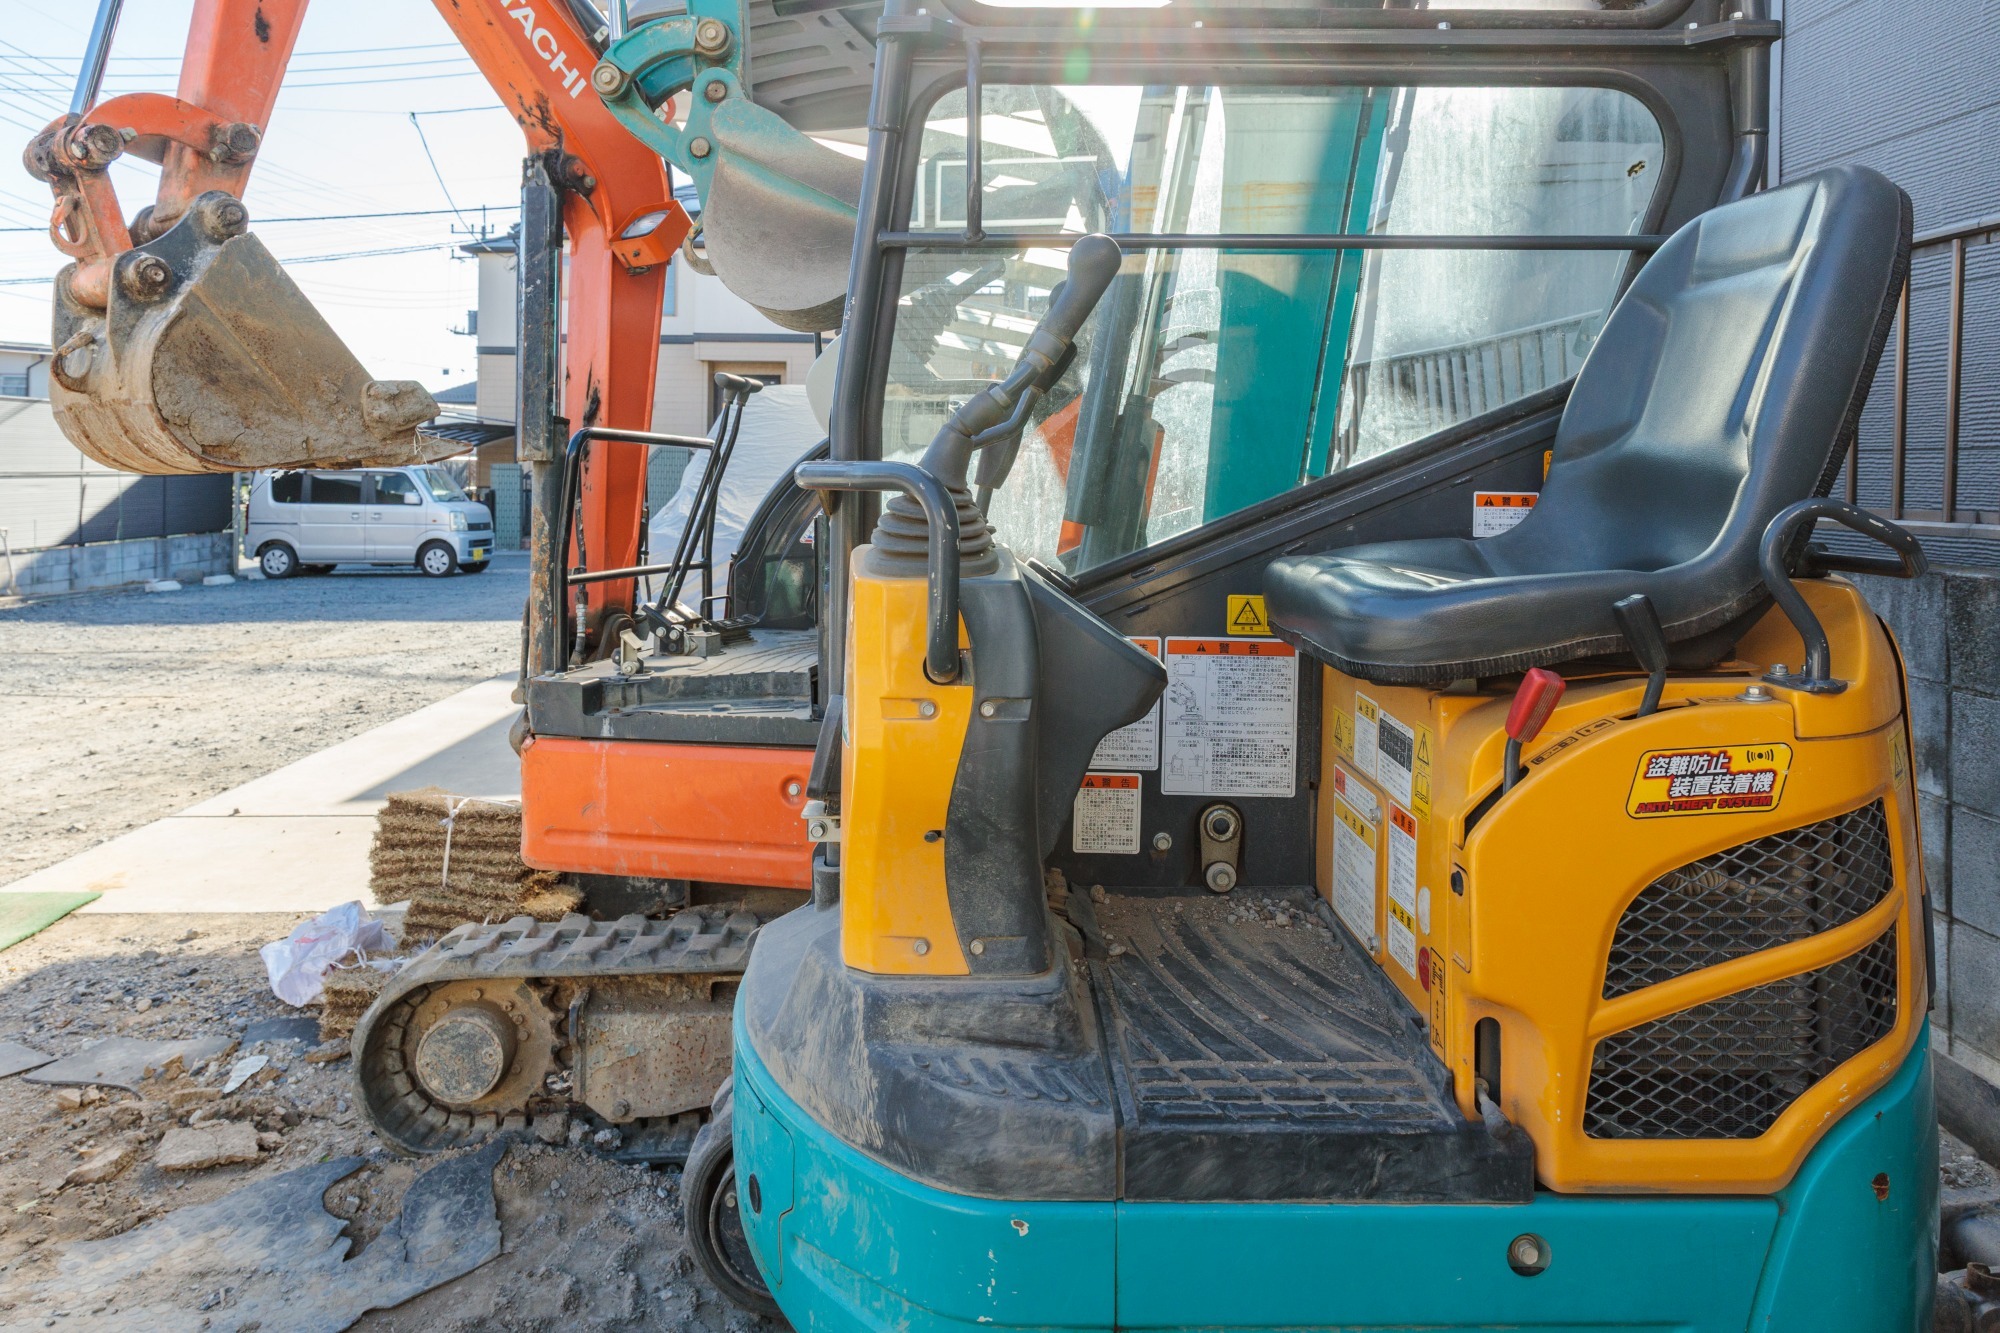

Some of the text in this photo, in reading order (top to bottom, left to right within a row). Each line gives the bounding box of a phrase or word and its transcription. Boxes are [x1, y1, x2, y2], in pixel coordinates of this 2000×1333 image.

[1219, 643, 1260, 655] 警告
[1646, 752, 1730, 778] 盗難防止
[1102, 777, 1131, 788] 警告
[1670, 771, 1775, 798] 装置装着機
[1635, 796, 1772, 814] ANTI-THEFT SYSTEM
